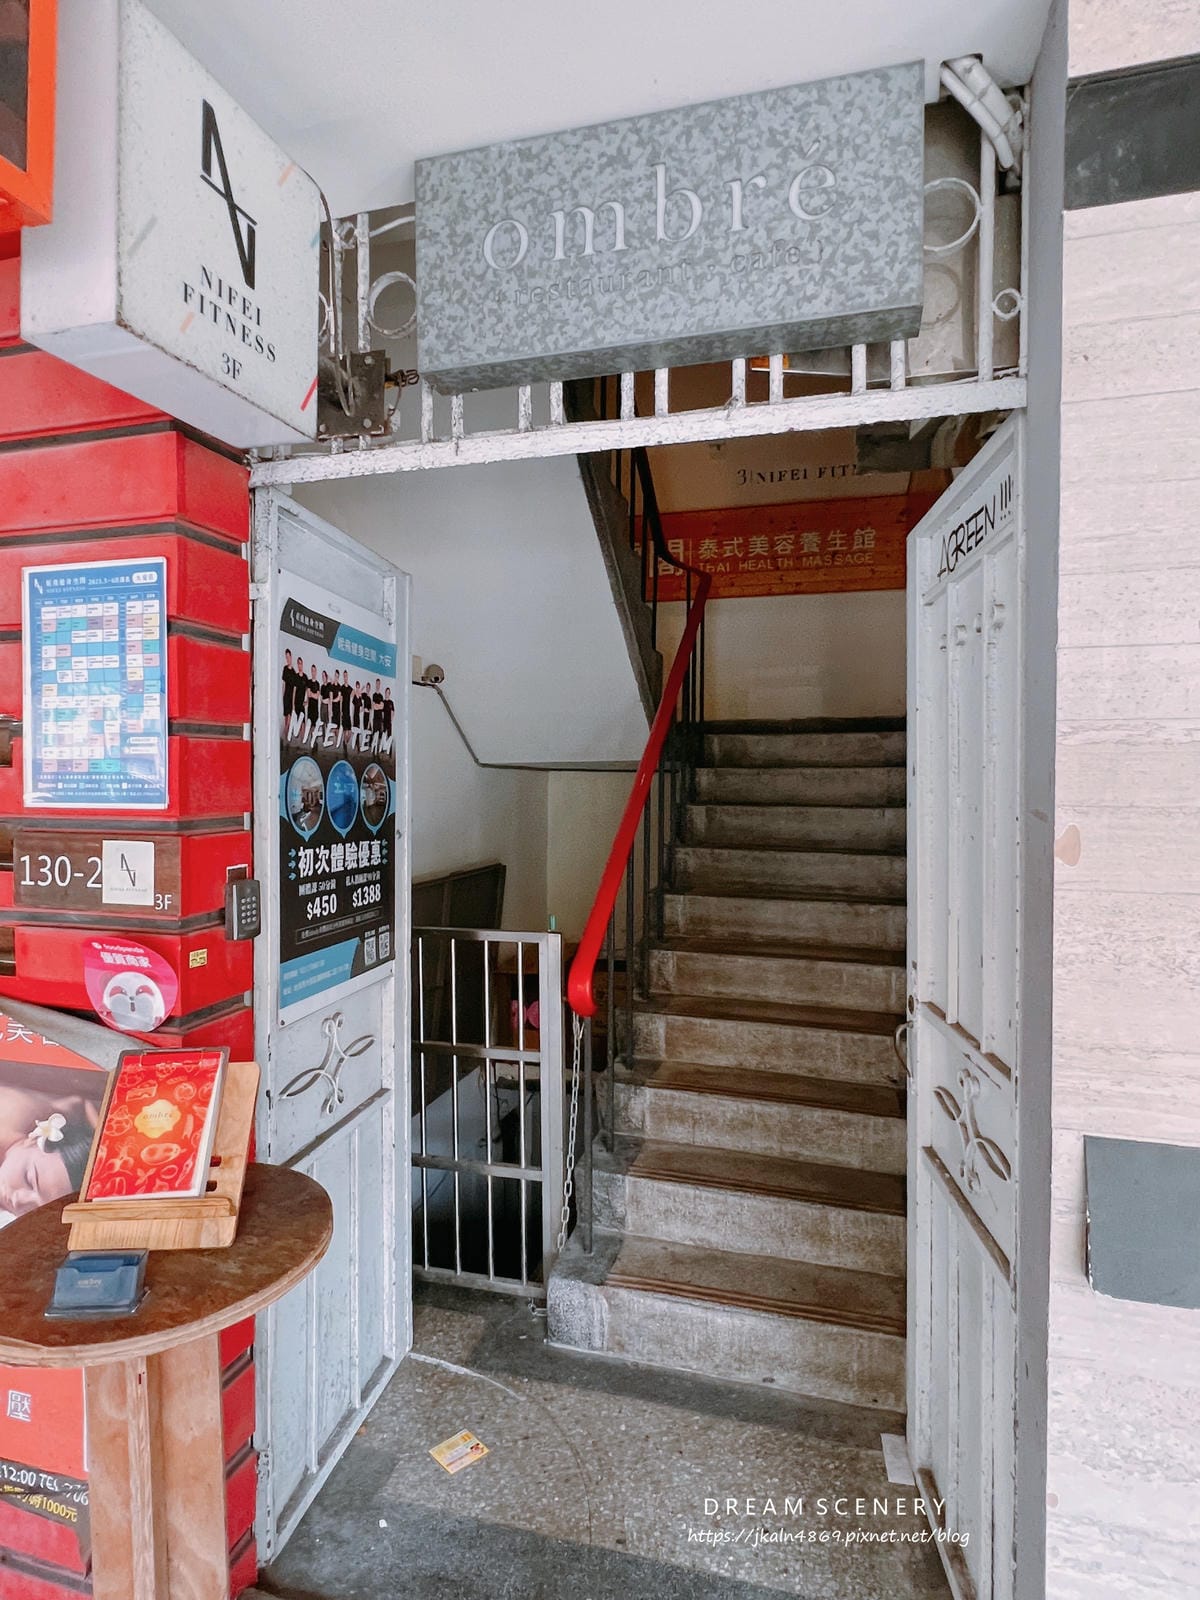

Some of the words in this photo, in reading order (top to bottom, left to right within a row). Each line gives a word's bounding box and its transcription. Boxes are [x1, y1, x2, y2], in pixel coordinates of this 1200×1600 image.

[483, 137, 837, 270] ombré
[201, 264, 261, 326] NIFEI
[182, 281, 276, 363] FITNESS
[221, 352, 242, 381] 3F
[698, 527, 876, 560] 泰式美容養生館
[739, 558, 793, 571] HEALTH
[802, 553, 874, 568] MASSAGE
[287, 710, 343, 748] NIFEI
[351, 726, 393, 755] TEAM
[20, 855, 102, 888] 130-2
[298, 840, 381, 878] 初次體驗優惠
[155, 894, 172, 910] 3F
[306, 893, 337, 921] $450
[352, 884, 381, 908] $1388
